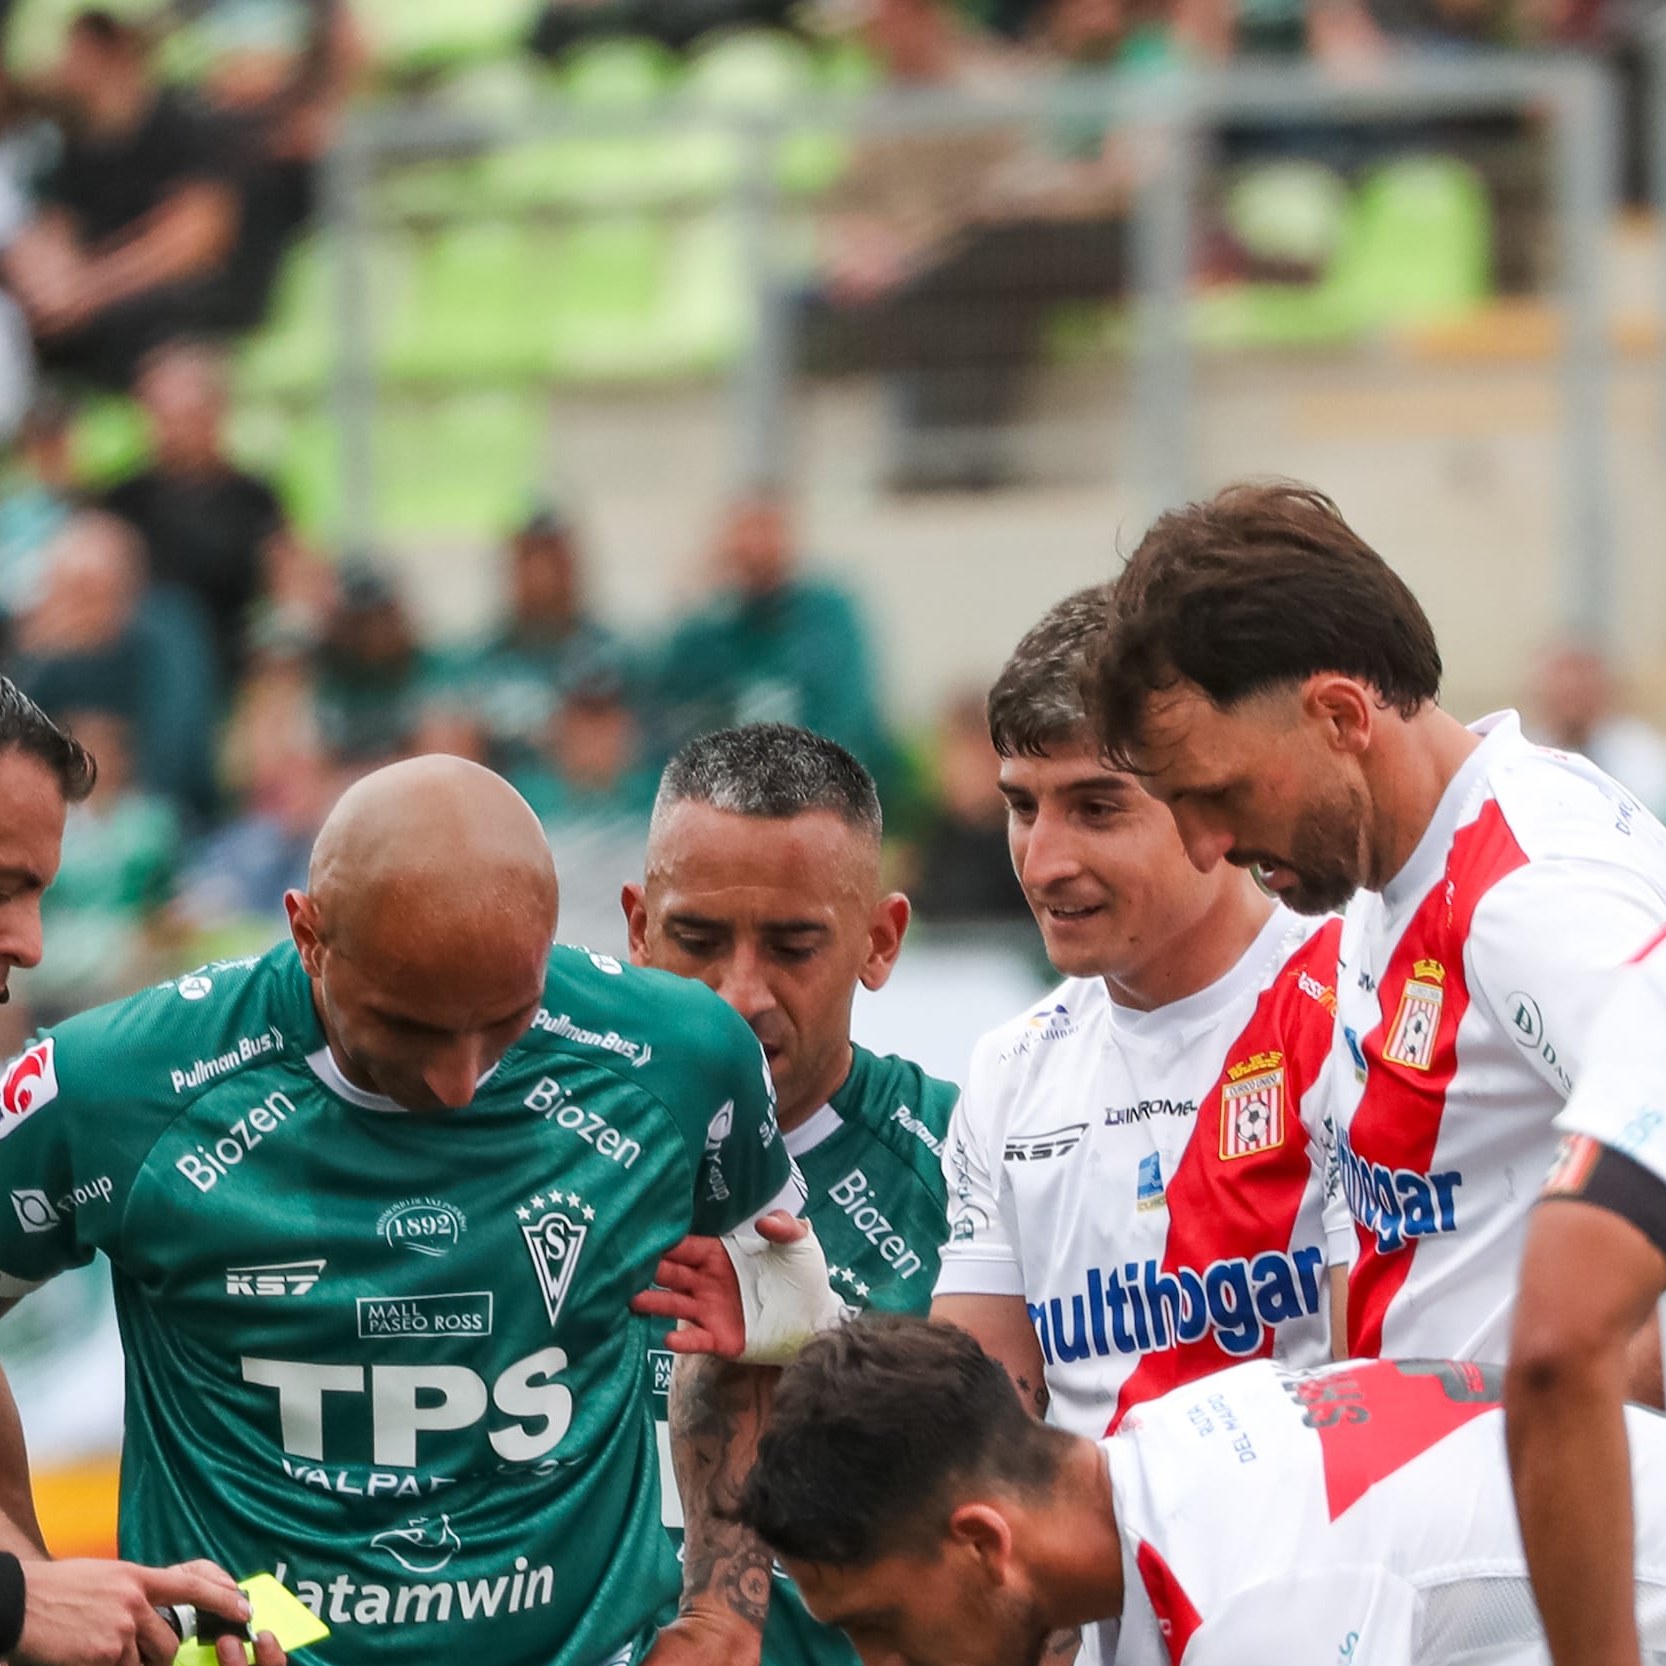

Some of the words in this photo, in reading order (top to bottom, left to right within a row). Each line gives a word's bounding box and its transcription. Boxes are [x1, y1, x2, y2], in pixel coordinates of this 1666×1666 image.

[523, 1075, 641, 1170] Biozen
[175, 1090, 297, 1193] Biozen
[1004, 1138, 1080, 1162] KS7
[393, 1213, 453, 1238] 1892
[828, 1168, 923, 1280] Biozen
[226, 1273, 320, 1296] KS7
[367, 1302, 421, 1320] MALL
[369, 1317, 428, 1333] PASEO
[434, 1313, 483, 1331] ROSS
[240, 1346, 573, 1468] TPS
